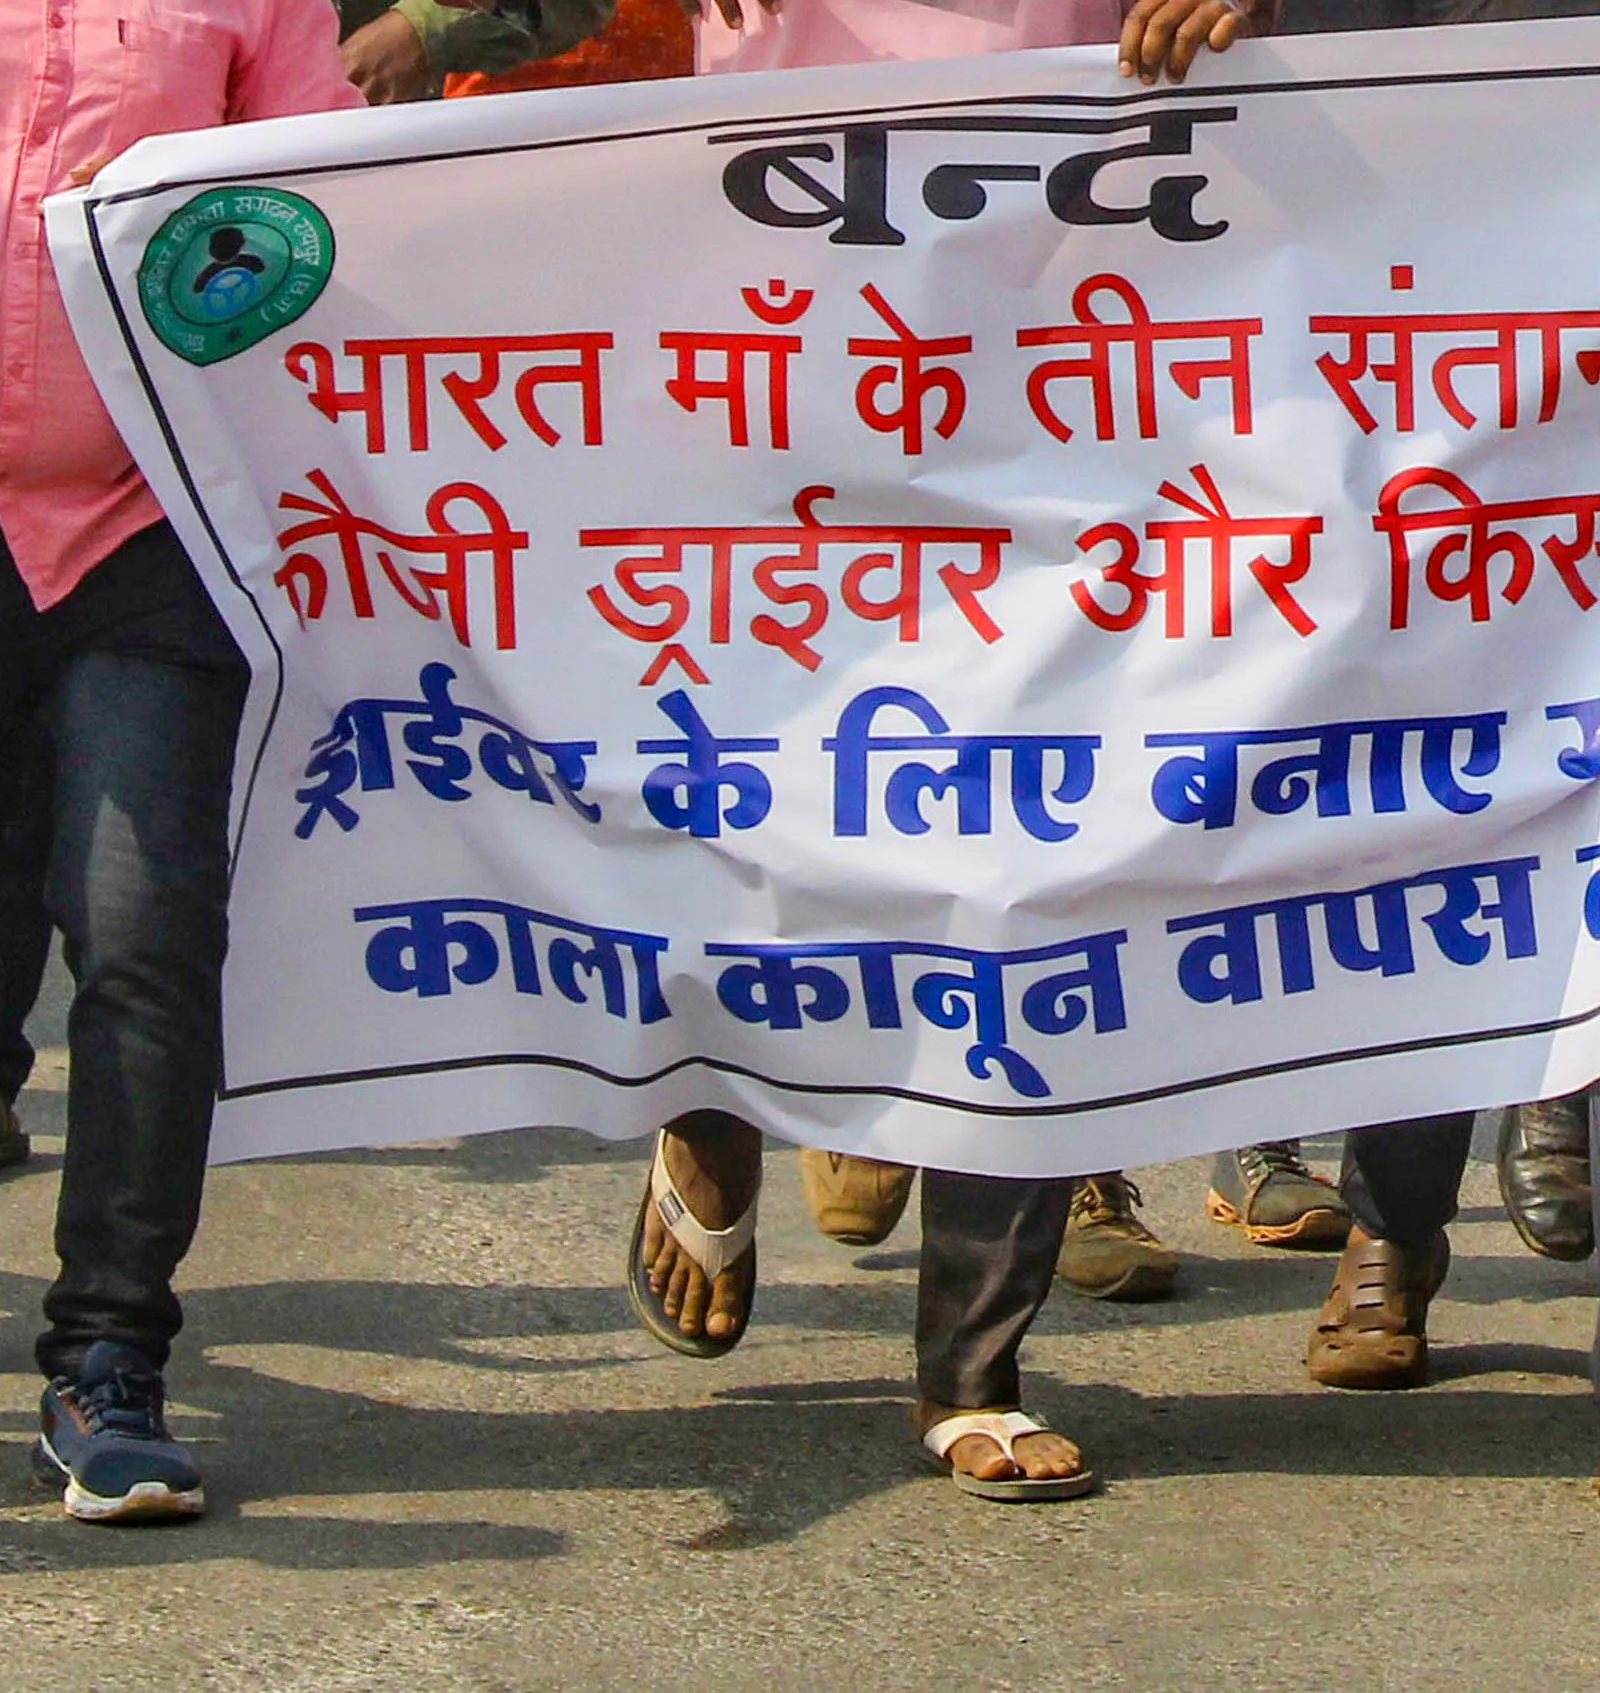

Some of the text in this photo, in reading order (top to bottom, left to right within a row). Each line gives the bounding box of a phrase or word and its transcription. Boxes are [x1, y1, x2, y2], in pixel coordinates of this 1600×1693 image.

[718, 102, 1238, 246] बन्द
[285, 332, 614, 453] भारत
[660, 279, 810, 449] माँ
[848, 283, 972, 455] के
[1017, 273, 1262, 442] तीन
[580, 486, 1012, 685] ड्राईवर
[1072, 464, 1323, 638] और
[637, 689, 778, 838] के
[823, 687, 1101, 842] लिए
[1146, 711, 1507, 829] बनाए
[355, 899, 670, 1023] काला
[705, 930, 1127, 1097] कानून
[1167, 857, 1539, 1004] वापस
